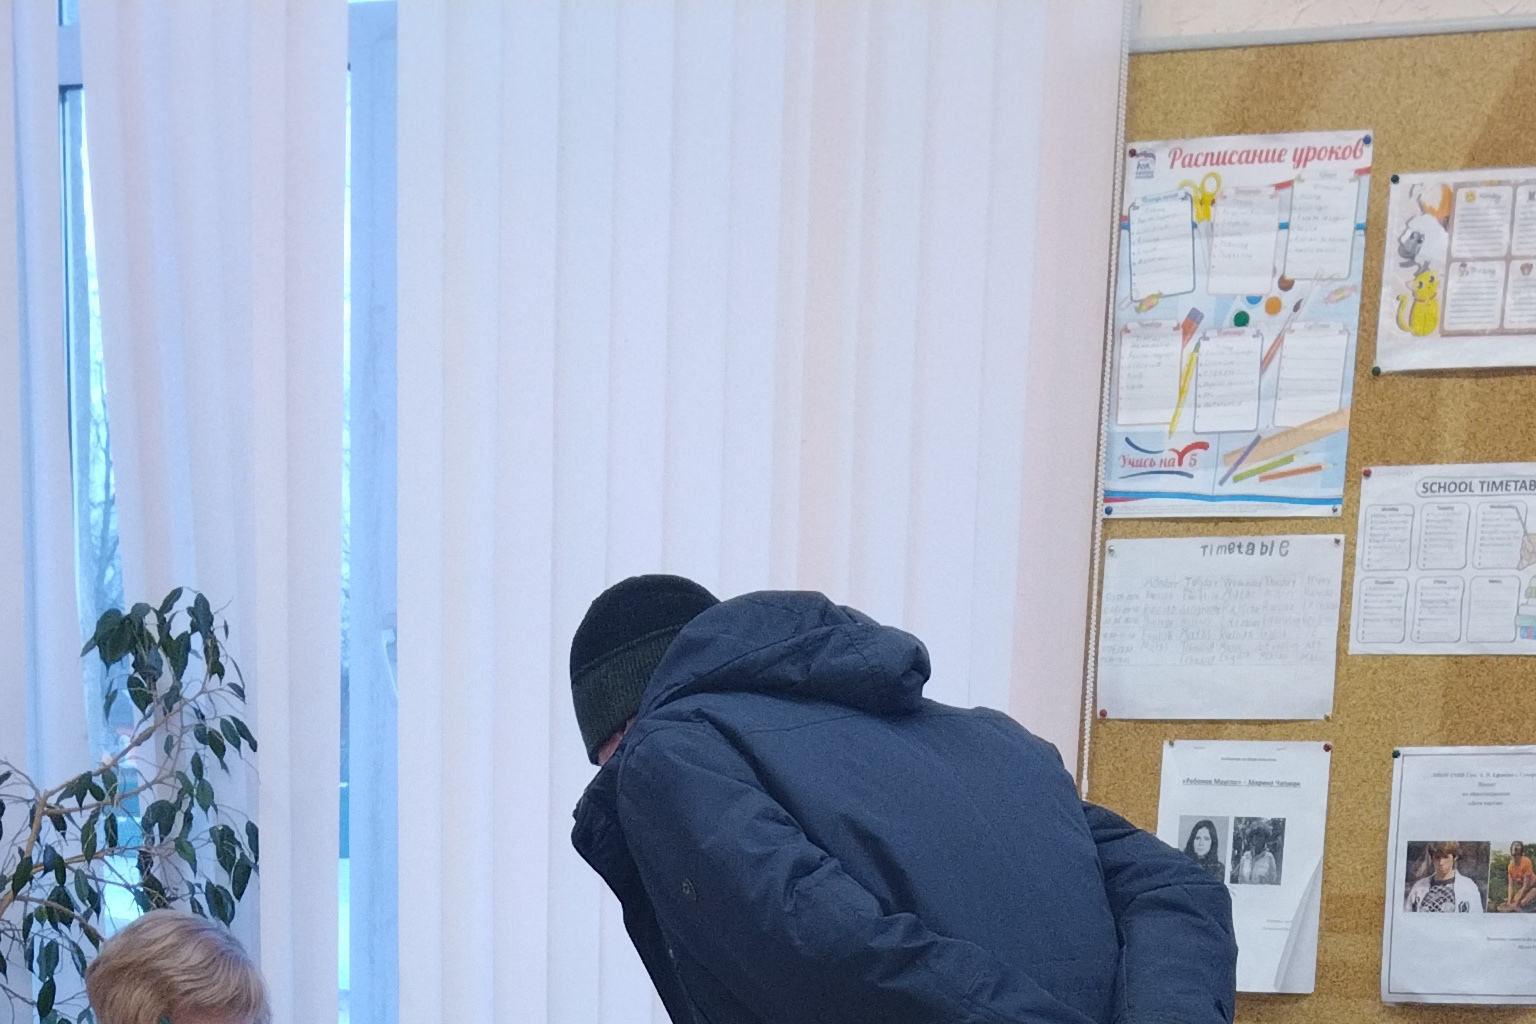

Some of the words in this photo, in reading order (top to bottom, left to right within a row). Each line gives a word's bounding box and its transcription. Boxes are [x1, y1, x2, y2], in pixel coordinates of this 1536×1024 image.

[1168, 146, 1288, 170] Расписание
[1292, 138, 1365, 168] уроков
[1119, 454, 1157, 468] Учись
[1421, 481, 1474, 493] SCHOOL
